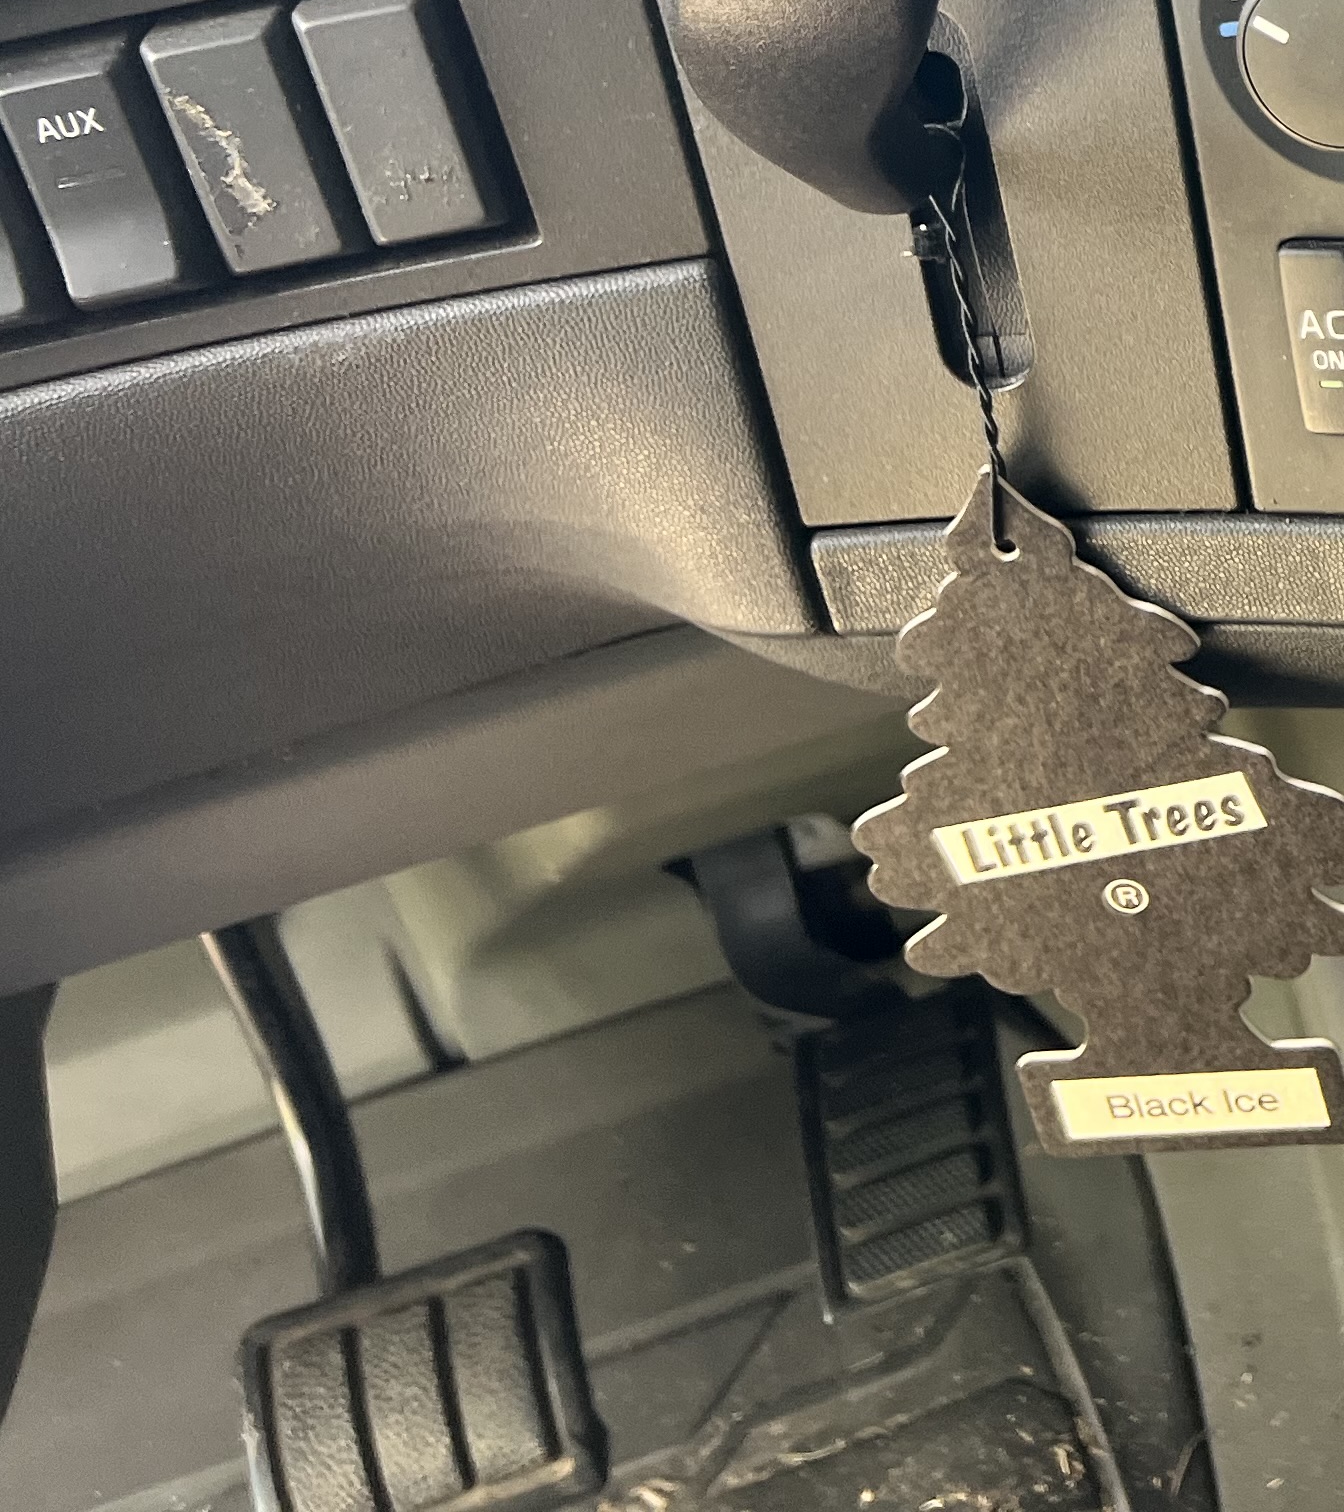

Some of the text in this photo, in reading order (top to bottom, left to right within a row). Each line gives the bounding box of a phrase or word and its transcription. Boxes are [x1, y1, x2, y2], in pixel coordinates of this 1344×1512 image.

[36, 107, 104, 144] AUX
[962, 794, 1245, 873] Little Trees
[1106, 1090, 1281, 1119] Black Ice
